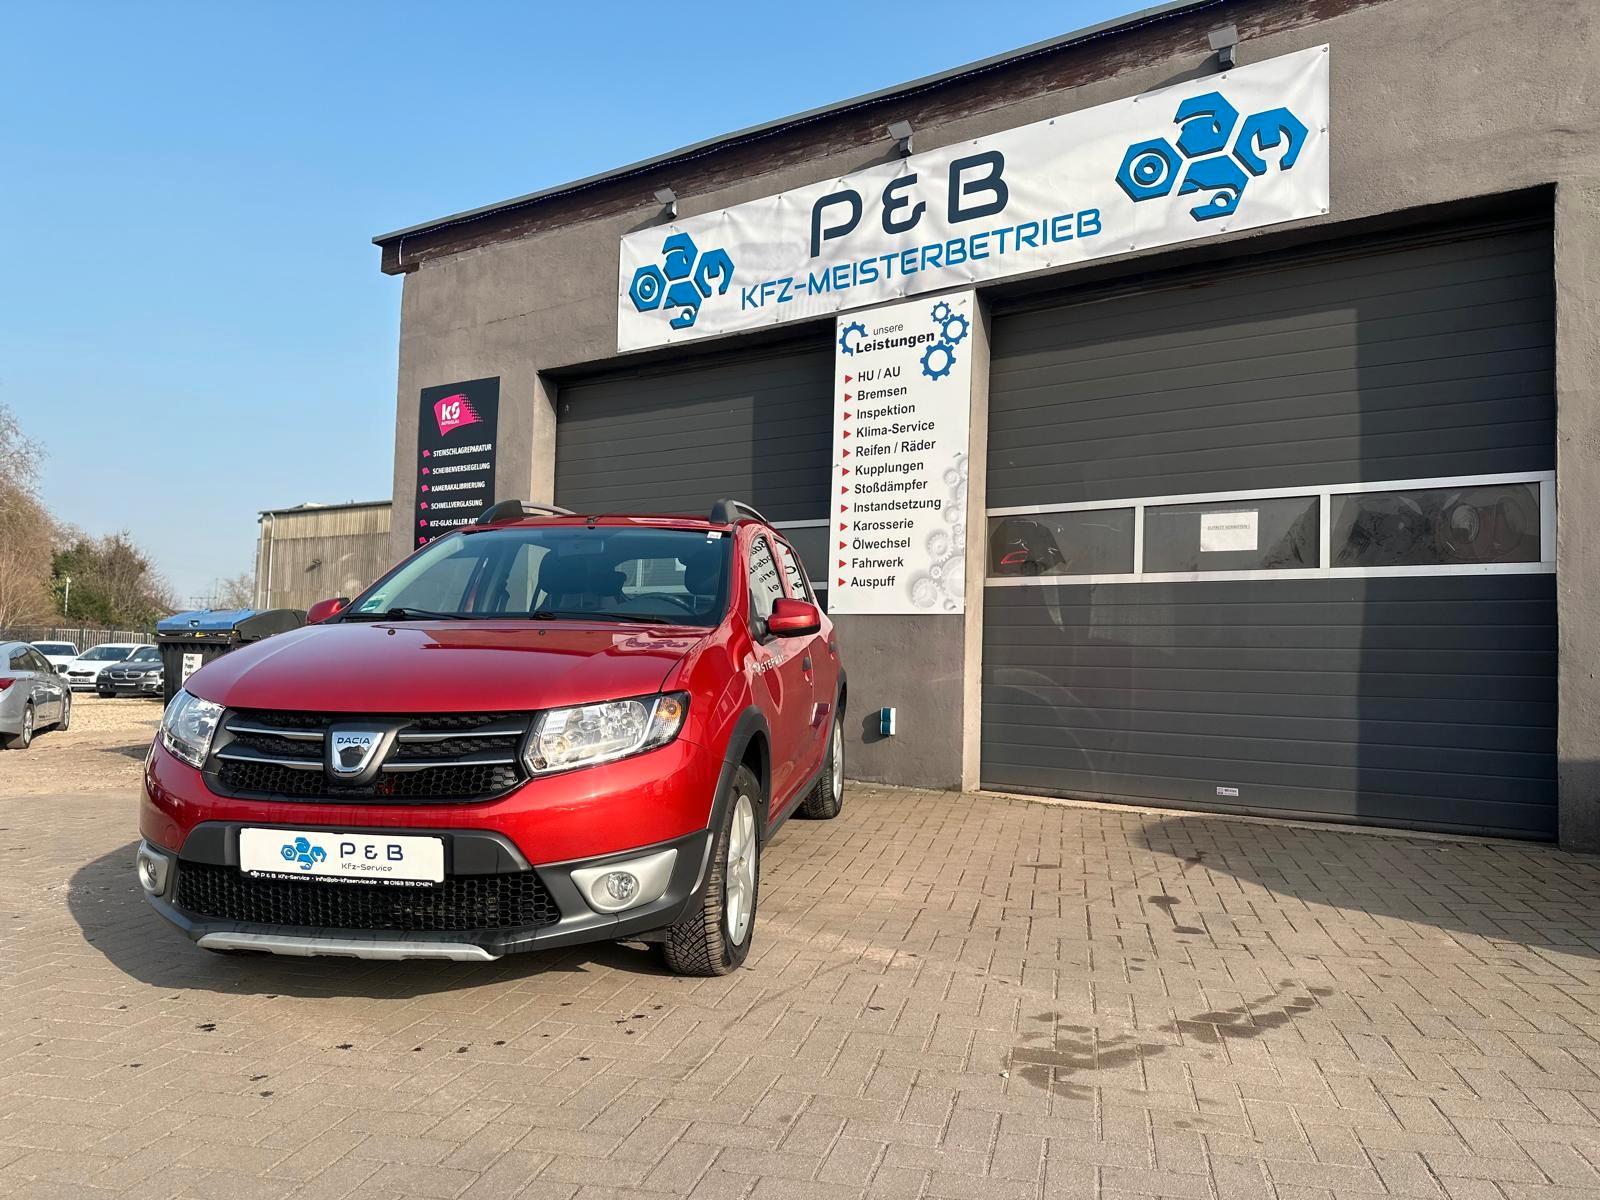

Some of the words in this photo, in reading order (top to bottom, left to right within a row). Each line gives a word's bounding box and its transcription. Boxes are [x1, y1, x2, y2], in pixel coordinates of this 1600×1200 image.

[809, 191, 863, 257] P
[881, 174, 926, 233] &
[947, 150, 1010, 224] B
[741, 208, 1103, 311] KFZ-MEISTERBETRIEB
[873, 324, 904, 336] unsere
[856, 332, 935, 354] Leistungen
[858, 370, 874, 383] HU
[883, 366, 901, 379] AU
[857, 386, 907, 401] Bremsen
[856, 404, 916, 420] Inspektion
[856, 420, 935, 438] Klima-Service
[433, 443, 492, 457] STEINSCHLAGREPARATUR
[855, 444, 891, 457] Reifen
[901, 438, 936, 453] Räder
[432, 462, 491, 475] SCHEIBENVERSIEGELUNG
[855, 462, 924, 477] Kupplungen
[431, 480, 486, 492] KAMERAKALIBRIERUNG
[854, 479, 928, 494] Stoßdämpfer
[430, 499, 483, 510] SCHNELLVERGLASUNG
[853, 499, 942, 513] Instandsetzung
[430, 519, 453, 527] KFZ-GLAS
[453, 518, 468, 526] ALLER
[468, 517, 479, 525] ART
[853, 518, 914, 531] Karosserie
[852, 537, 911, 550] Ölwechsel
[852, 556, 904, 569] Fahrwerk
[850, 575, 896, 589] Auspuff
[339, 842, 356, 859] P
[364, 844, 378, 860] &
[386, 844, 404, 861] B
[341, 862, 393, 873] Kfz-Service
